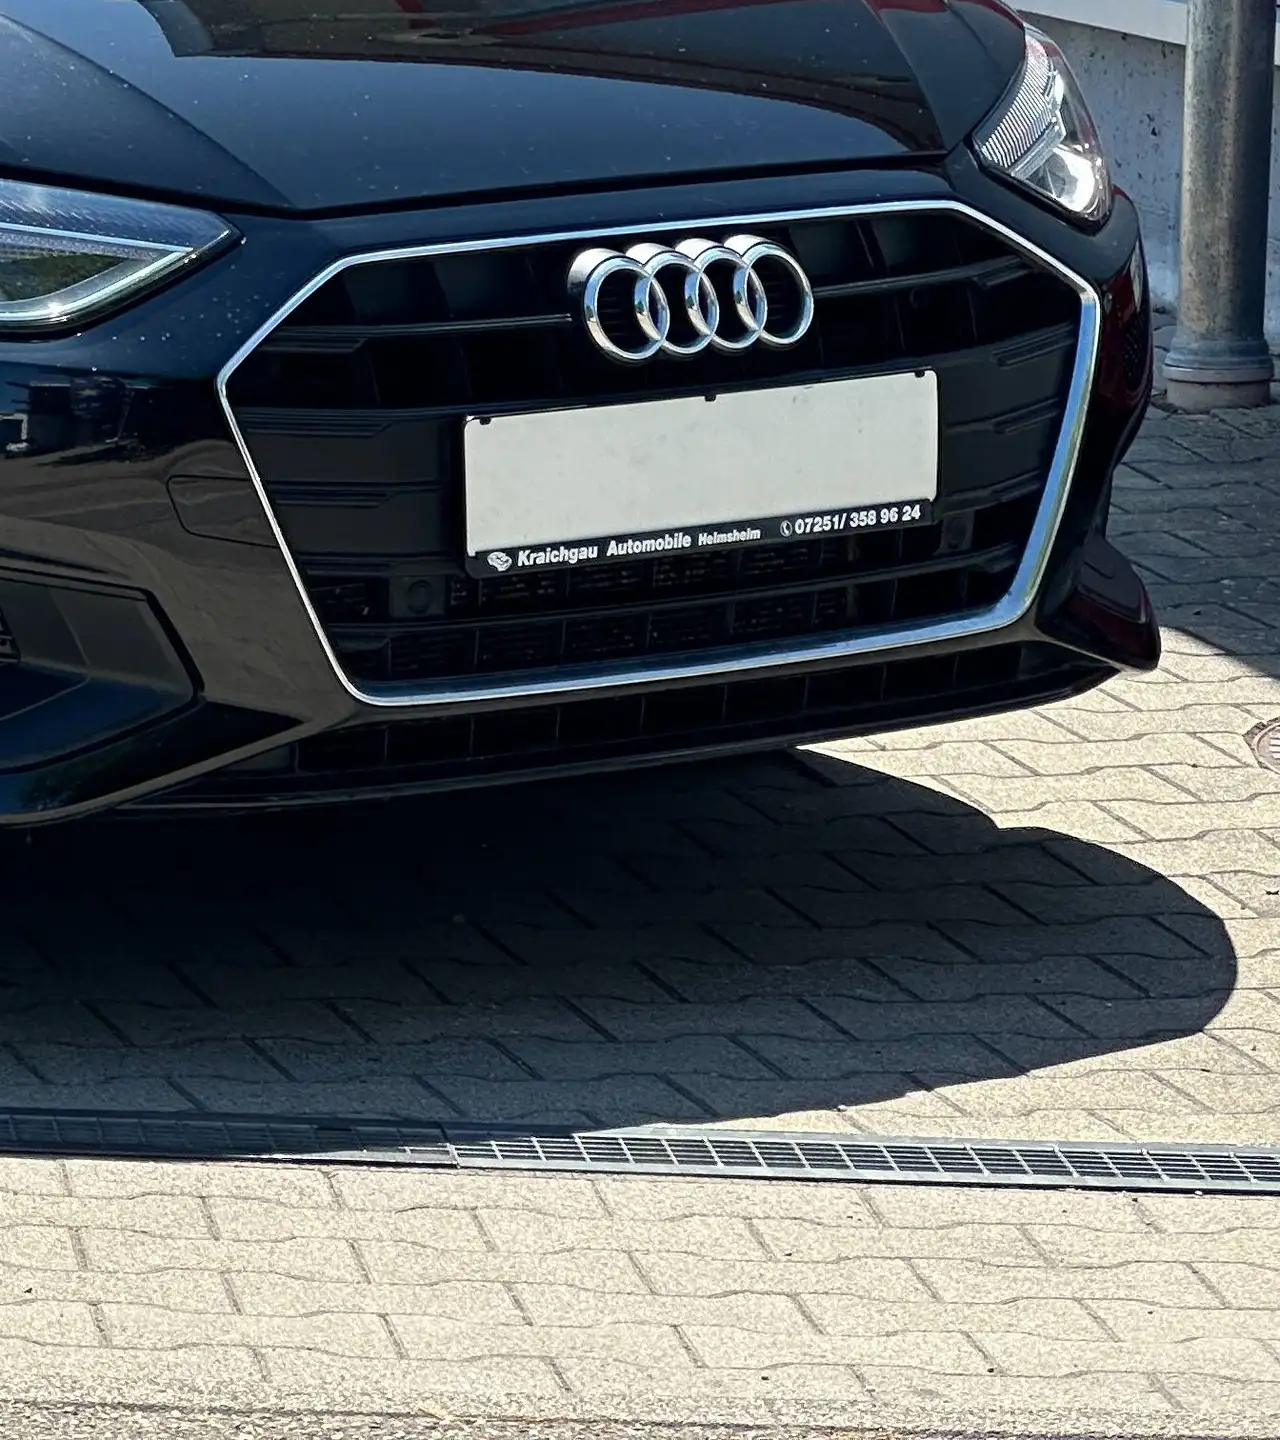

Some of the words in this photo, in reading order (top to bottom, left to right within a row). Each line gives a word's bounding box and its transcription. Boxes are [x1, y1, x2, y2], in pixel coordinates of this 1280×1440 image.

[517, 542, 599, 568] Kraichgau
[606, 532, 692, 558] Automobile
[698, 526, 762, 547] Helmsheim
[794, 512, 849, 534] 07251/
[850, 508, 877, 529] 358
[879, 505, 901, 525] 96
[902, 503, 922, 523] 24
